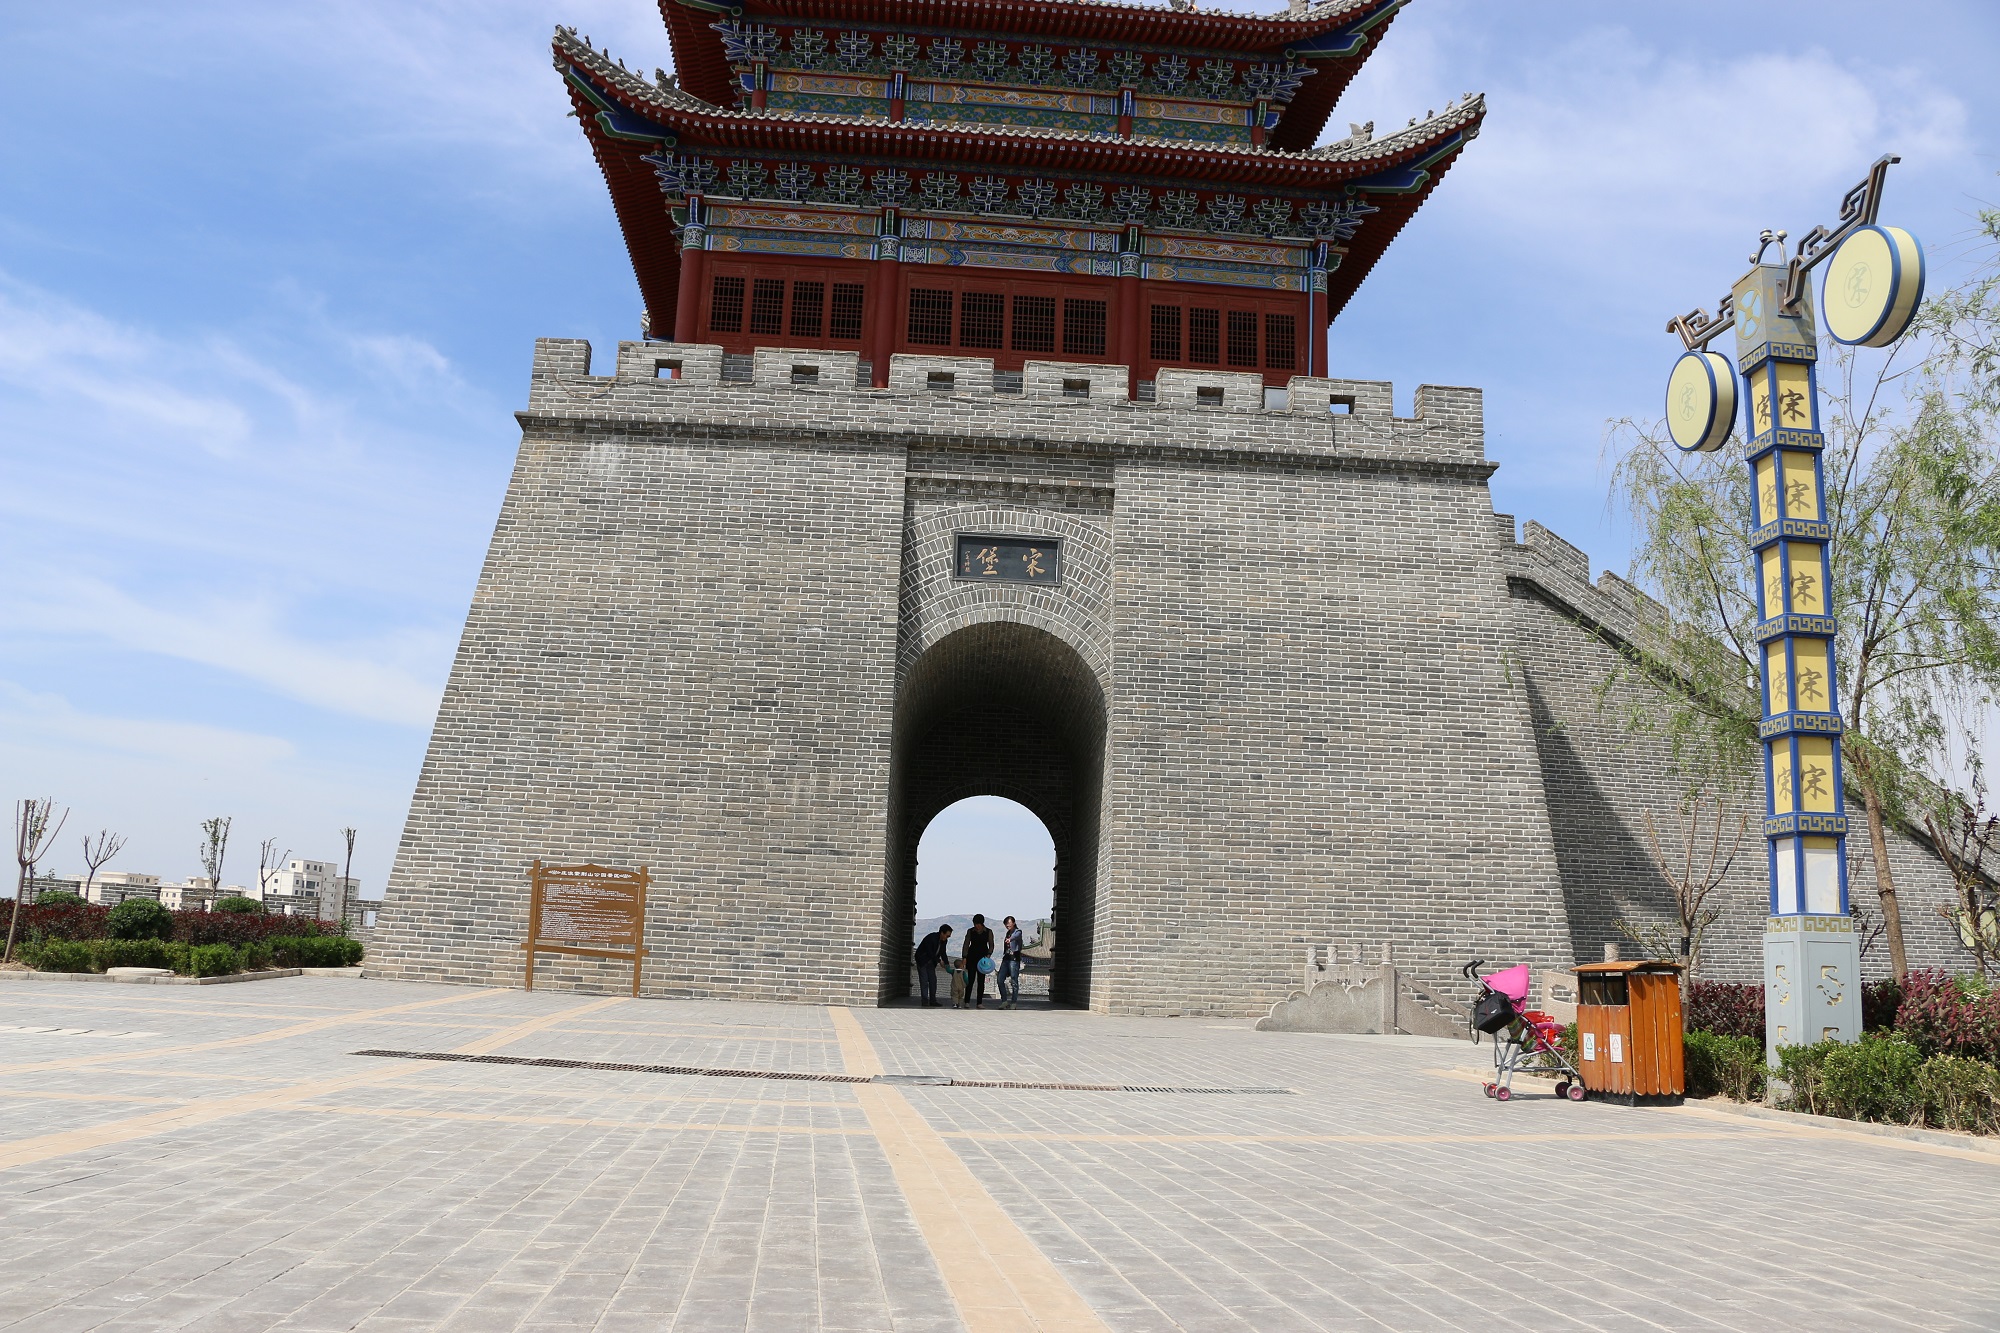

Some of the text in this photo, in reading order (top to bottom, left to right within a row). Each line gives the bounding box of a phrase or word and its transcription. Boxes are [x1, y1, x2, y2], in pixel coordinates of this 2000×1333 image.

[1779, 388, 1806, 422] 宋
[1785, 478, 1811, 513] 宋
[1790, 571, 1817, 606] 宋
[1797, 666, 1824, 702] 宋
[1801, 763, 1828, 801] 宋
